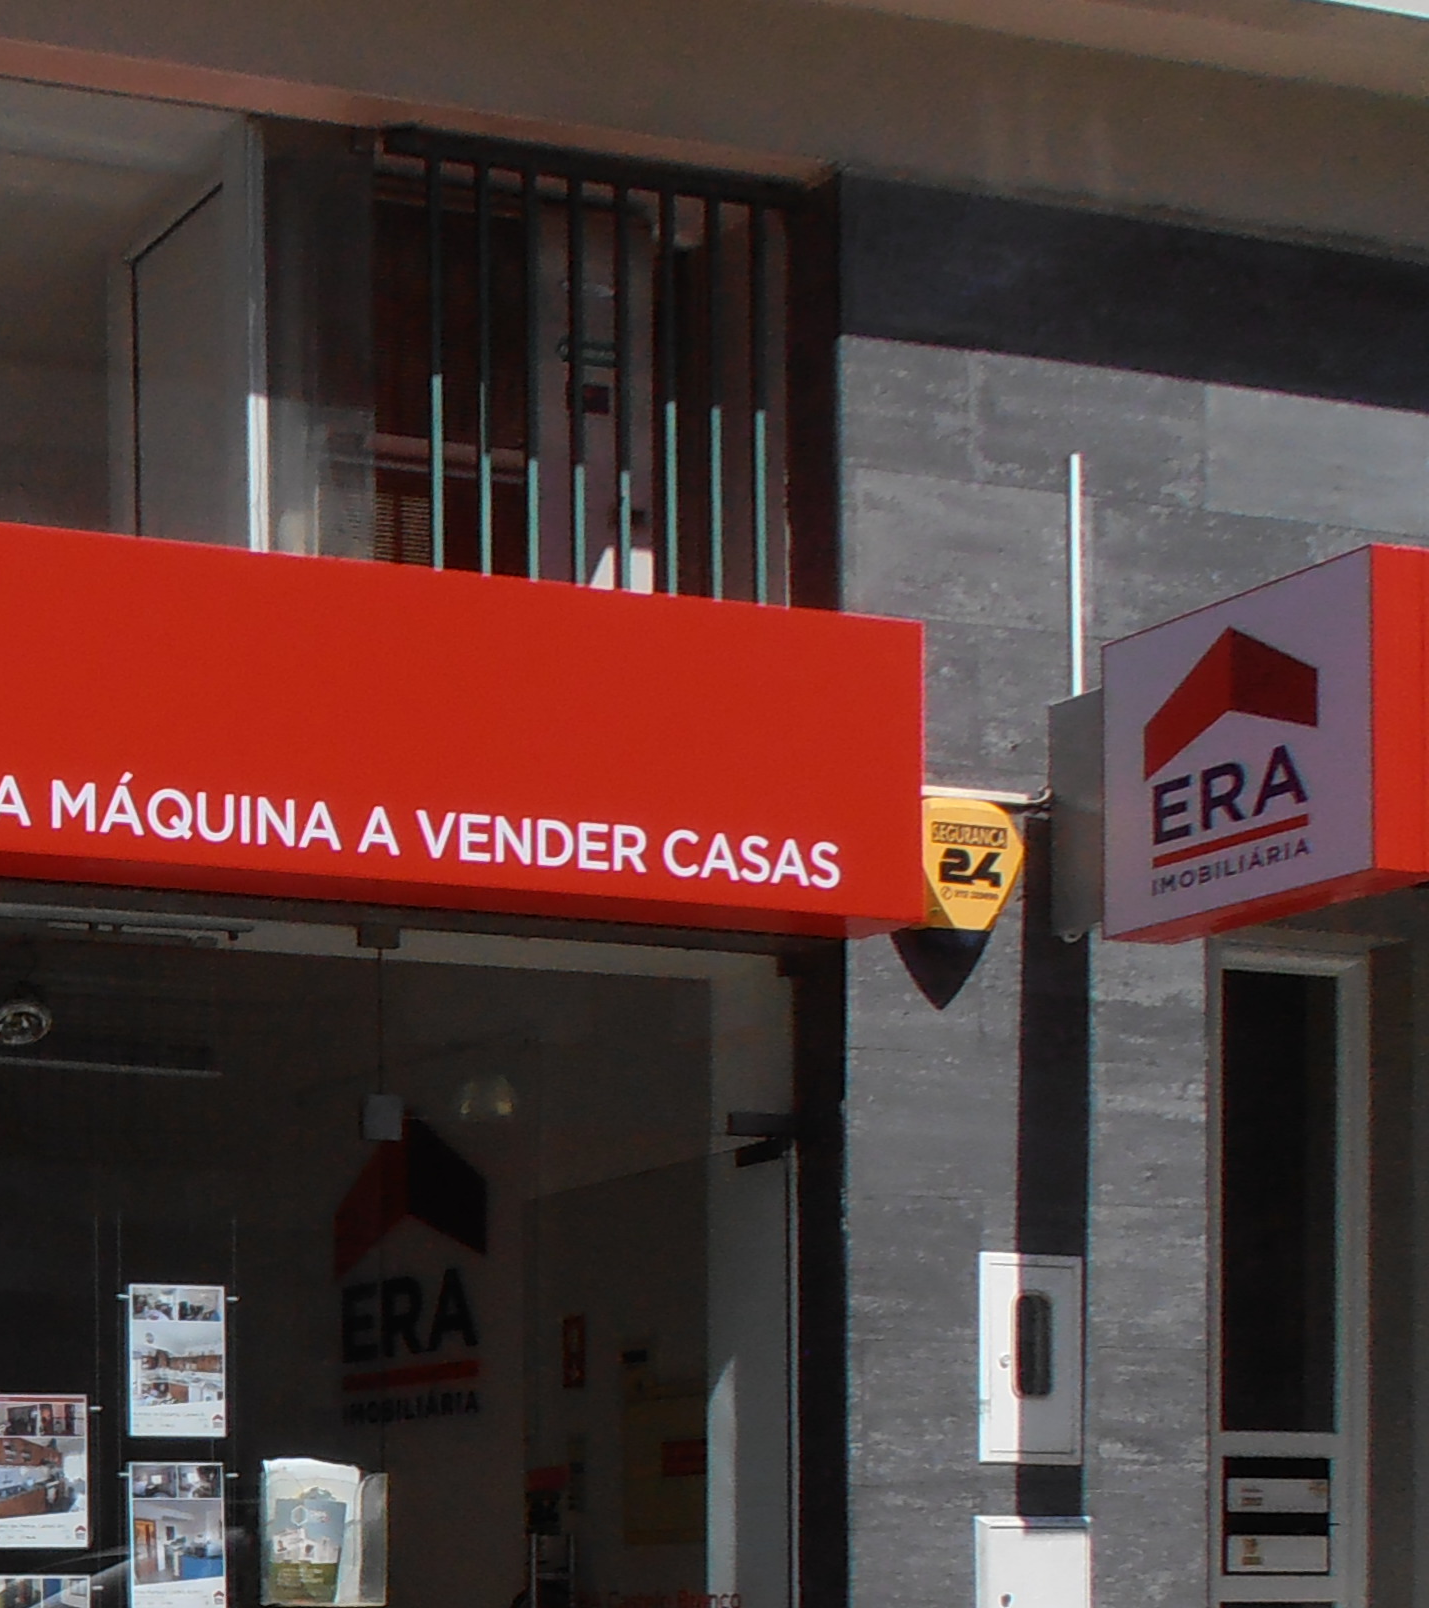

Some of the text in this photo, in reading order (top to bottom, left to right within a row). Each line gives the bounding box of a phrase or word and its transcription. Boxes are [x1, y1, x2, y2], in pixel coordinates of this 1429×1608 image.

[51, 771, 342, 851] MÁQUINA
[357, 806, 400, 856] A
[416, 809, 647, 873] VENDER
[663, 829, 840, 889] CASAS
[1152, 744, 1310, 845] ERA
[939, 848, 1002, 888] 24
[1152, 837, 1310, 897] IMOBILIÁRIA
[342, 1267, 479, 1364] ERA
